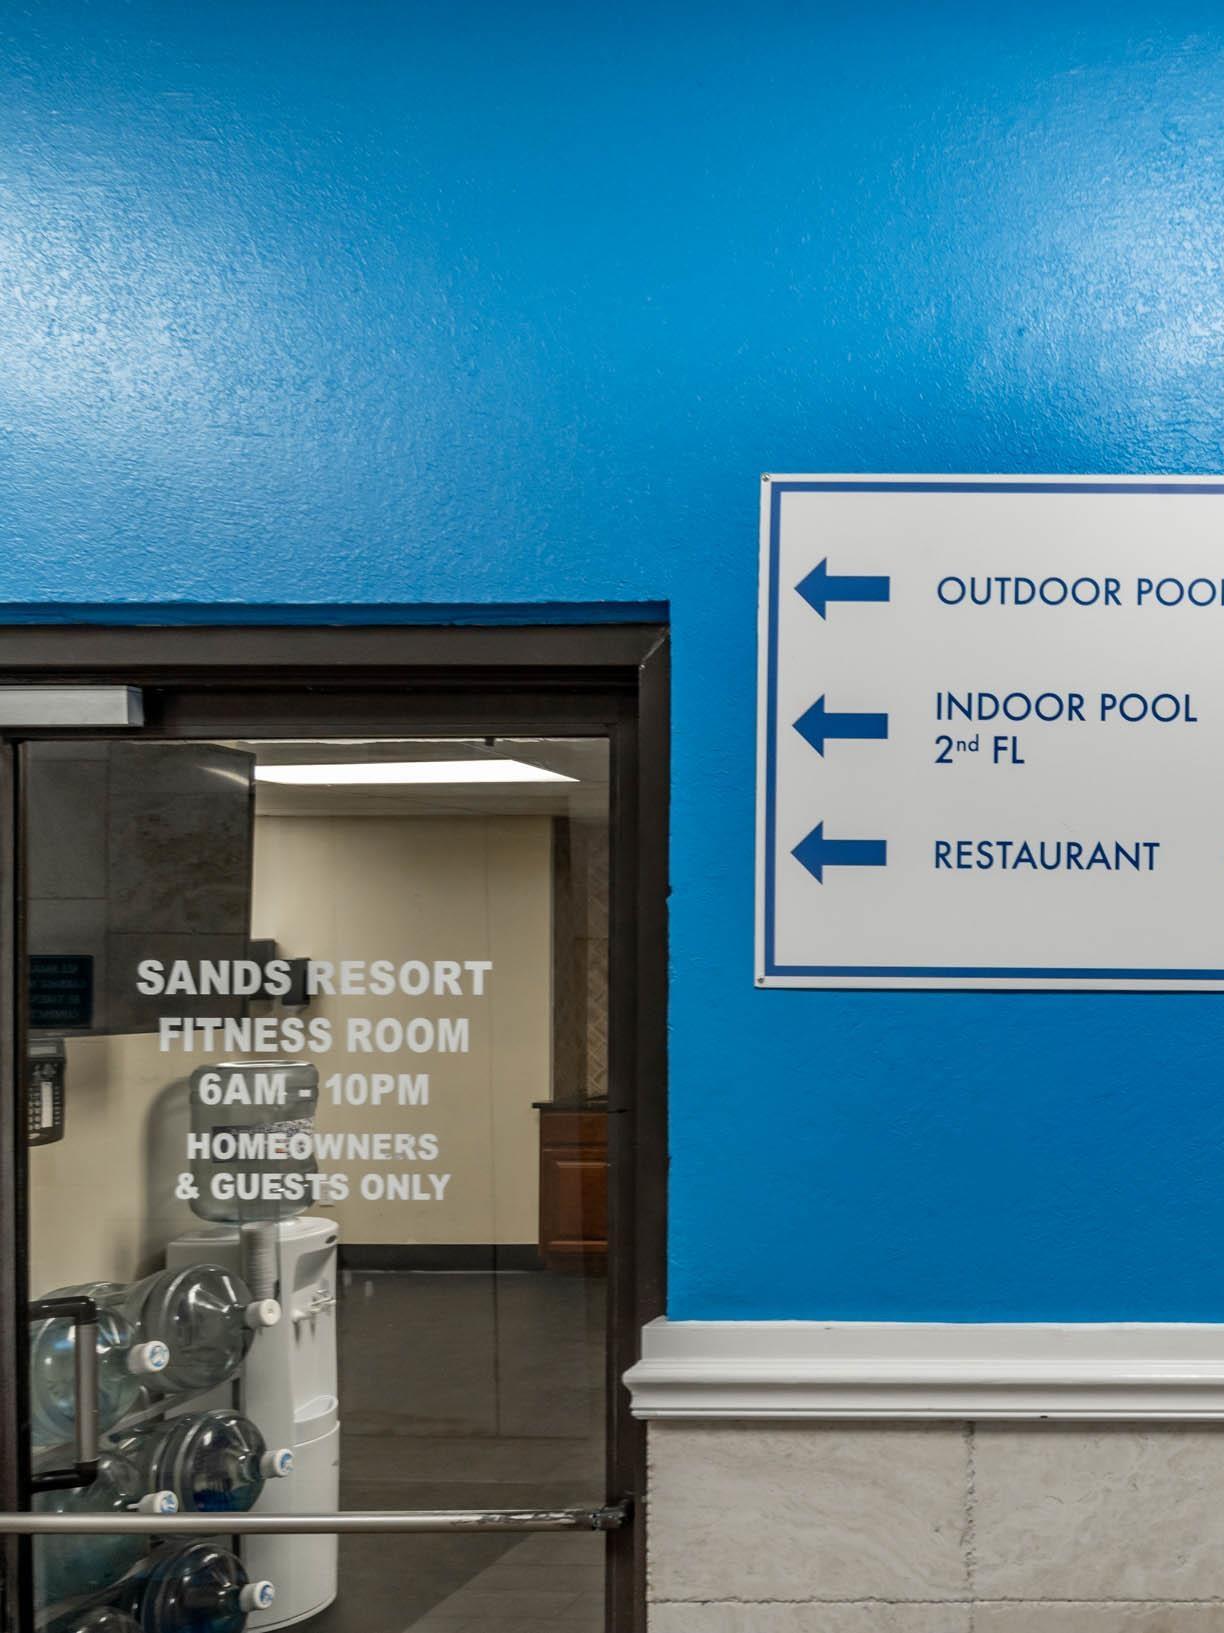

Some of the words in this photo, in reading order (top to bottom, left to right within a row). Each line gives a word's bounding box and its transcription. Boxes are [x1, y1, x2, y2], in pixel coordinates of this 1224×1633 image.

[937, 576, 1122, 606] OUTDOOR
[936, 691, 1086, 722] INDOOR
[1100, 693, 1198, 723] POOL
[935, 734, 979, 764] 2nd
[993, 735, 1025, 765] FL
[935, 840, 1161, 871] RESTAURANT
[136, 959, 293, 996] SANDS
[306, 959, 493, 996] RESORT
[158, 1017, 334, 1053] FITNESS
[346, 1017, 470, 1053] ROOM
[198, 1072, 287, 1106] 6AM
[299, 1089, 312, 1098] -
[325, 1073, 430, 1106] 10PM
[186, 1132, 440, 1161] HOMEOWNERS
[175, 1172, 200, 1201] &
[210, 1172, 350, 1201] GUESTS
[360, 1173, 451, 1202] ONLY
